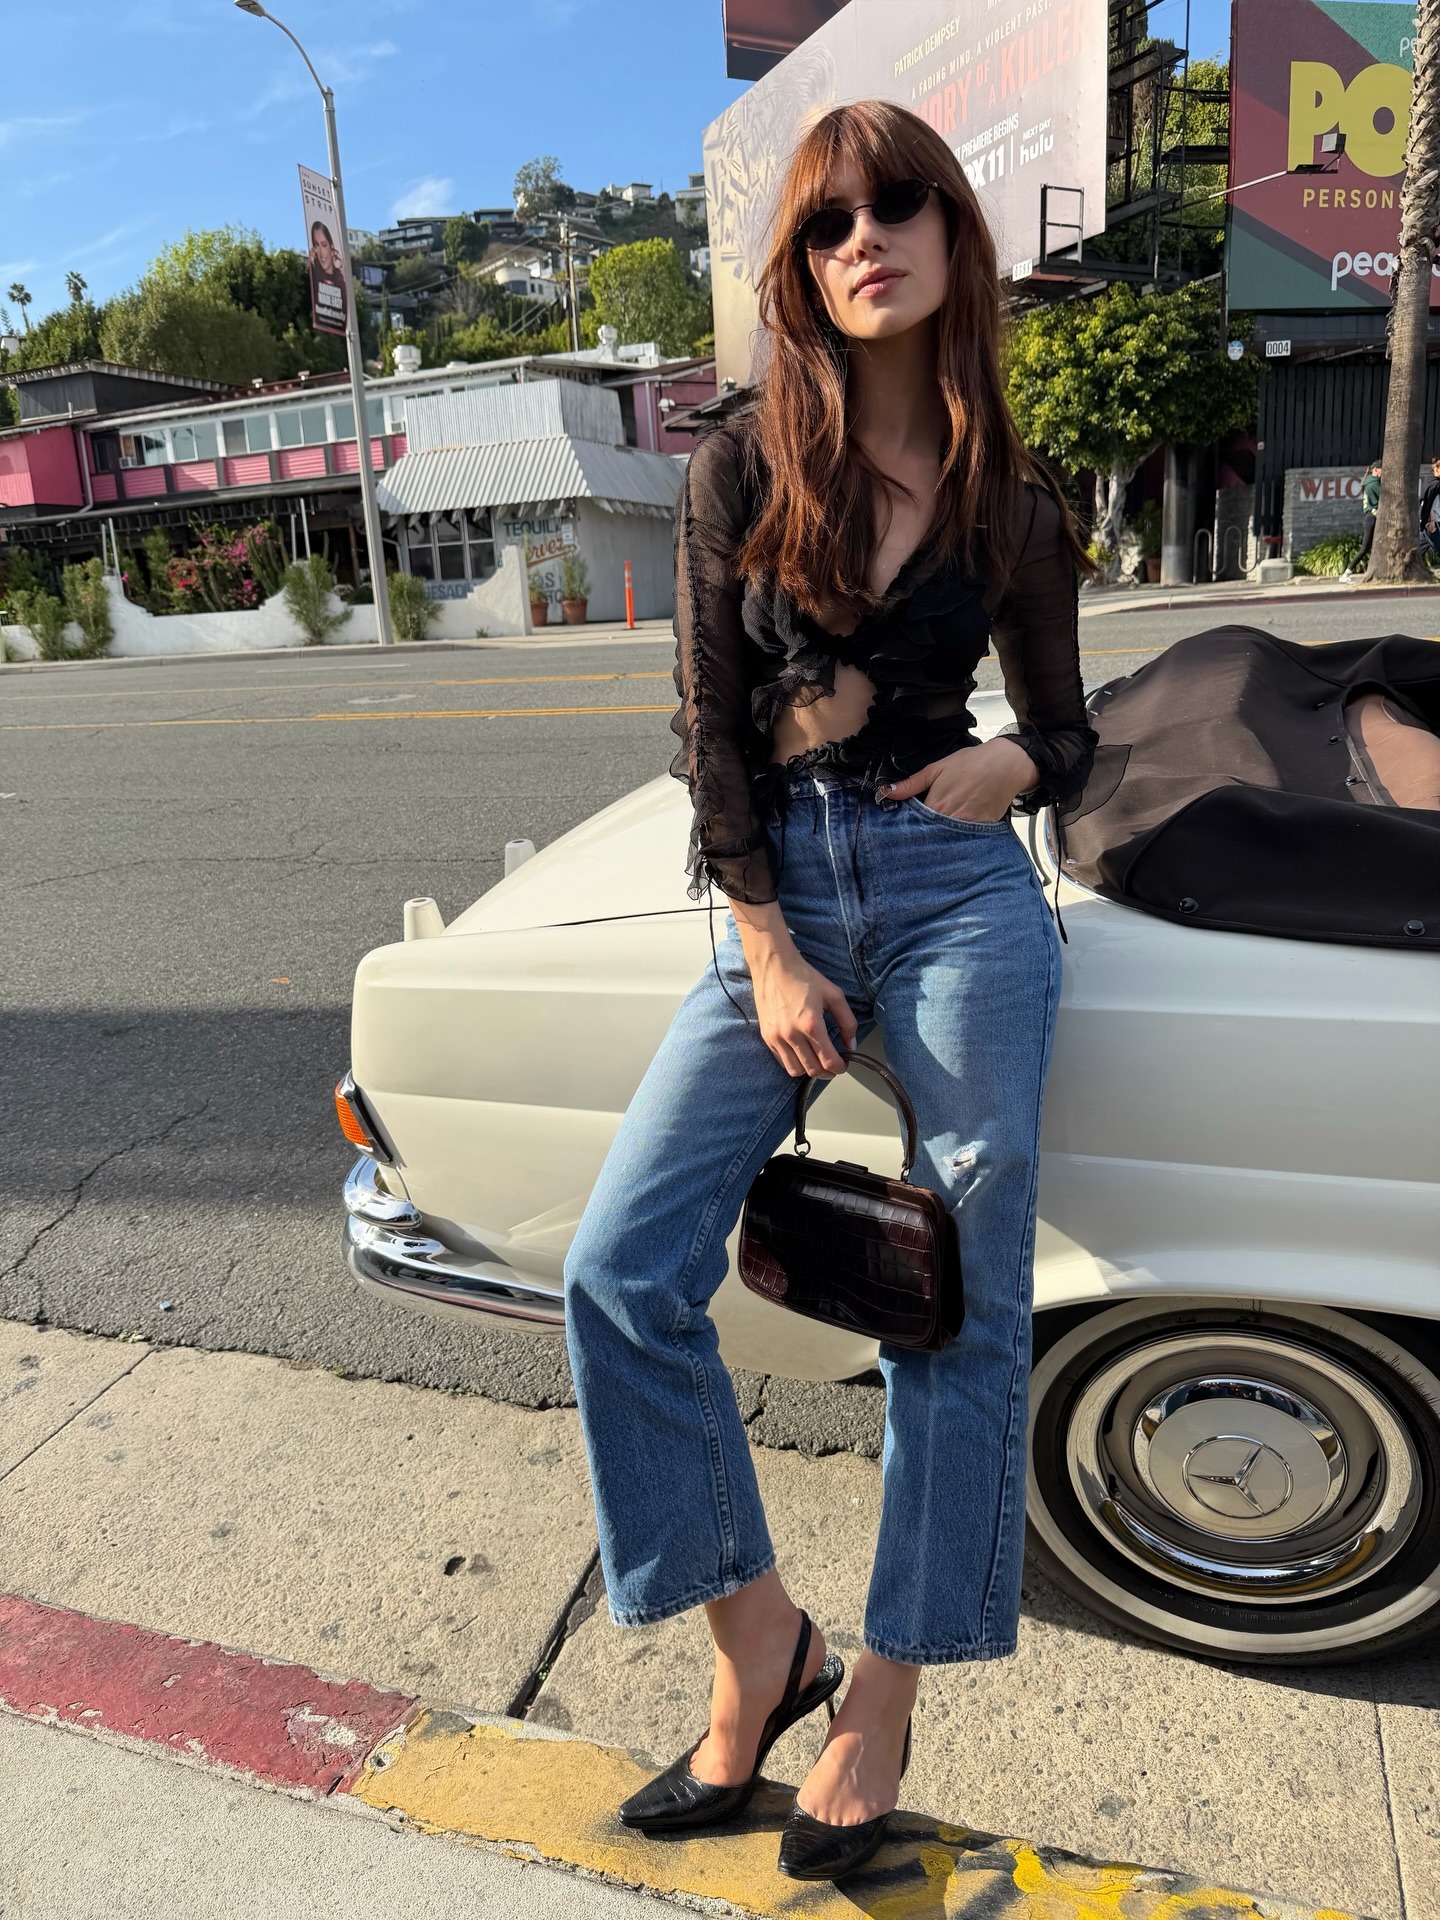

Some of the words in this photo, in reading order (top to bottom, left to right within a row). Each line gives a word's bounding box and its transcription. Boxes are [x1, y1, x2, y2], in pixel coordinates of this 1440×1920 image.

[894, 42, 924, 78] PATRICK
[925, 15, 961, 56] DEMPSEY
[911, 87, 917, 101] A
[919, 66, 946, 96] FADING
[949, 49, 973, 75] MIND.
[976, 40, 982, 56] A
[985, 12, 1022, 49] VIOLENT
[976, 58, 990, 88] OF
[988, 84, 996, 108] A
[1001, 0, 1088, 101] KILLER
[961, 127, 993, 160] PREMIERE
[993, 112, 1019, 142] BEGINS
[1022, 124, 1040, 141] NEXT
[1039, 117, 1052, 132] DAY
[1020, 133, 1054, 166] hulu
[305, 194, 333, 214] STRIP
[1267, 342, 1289, 355] 0004
